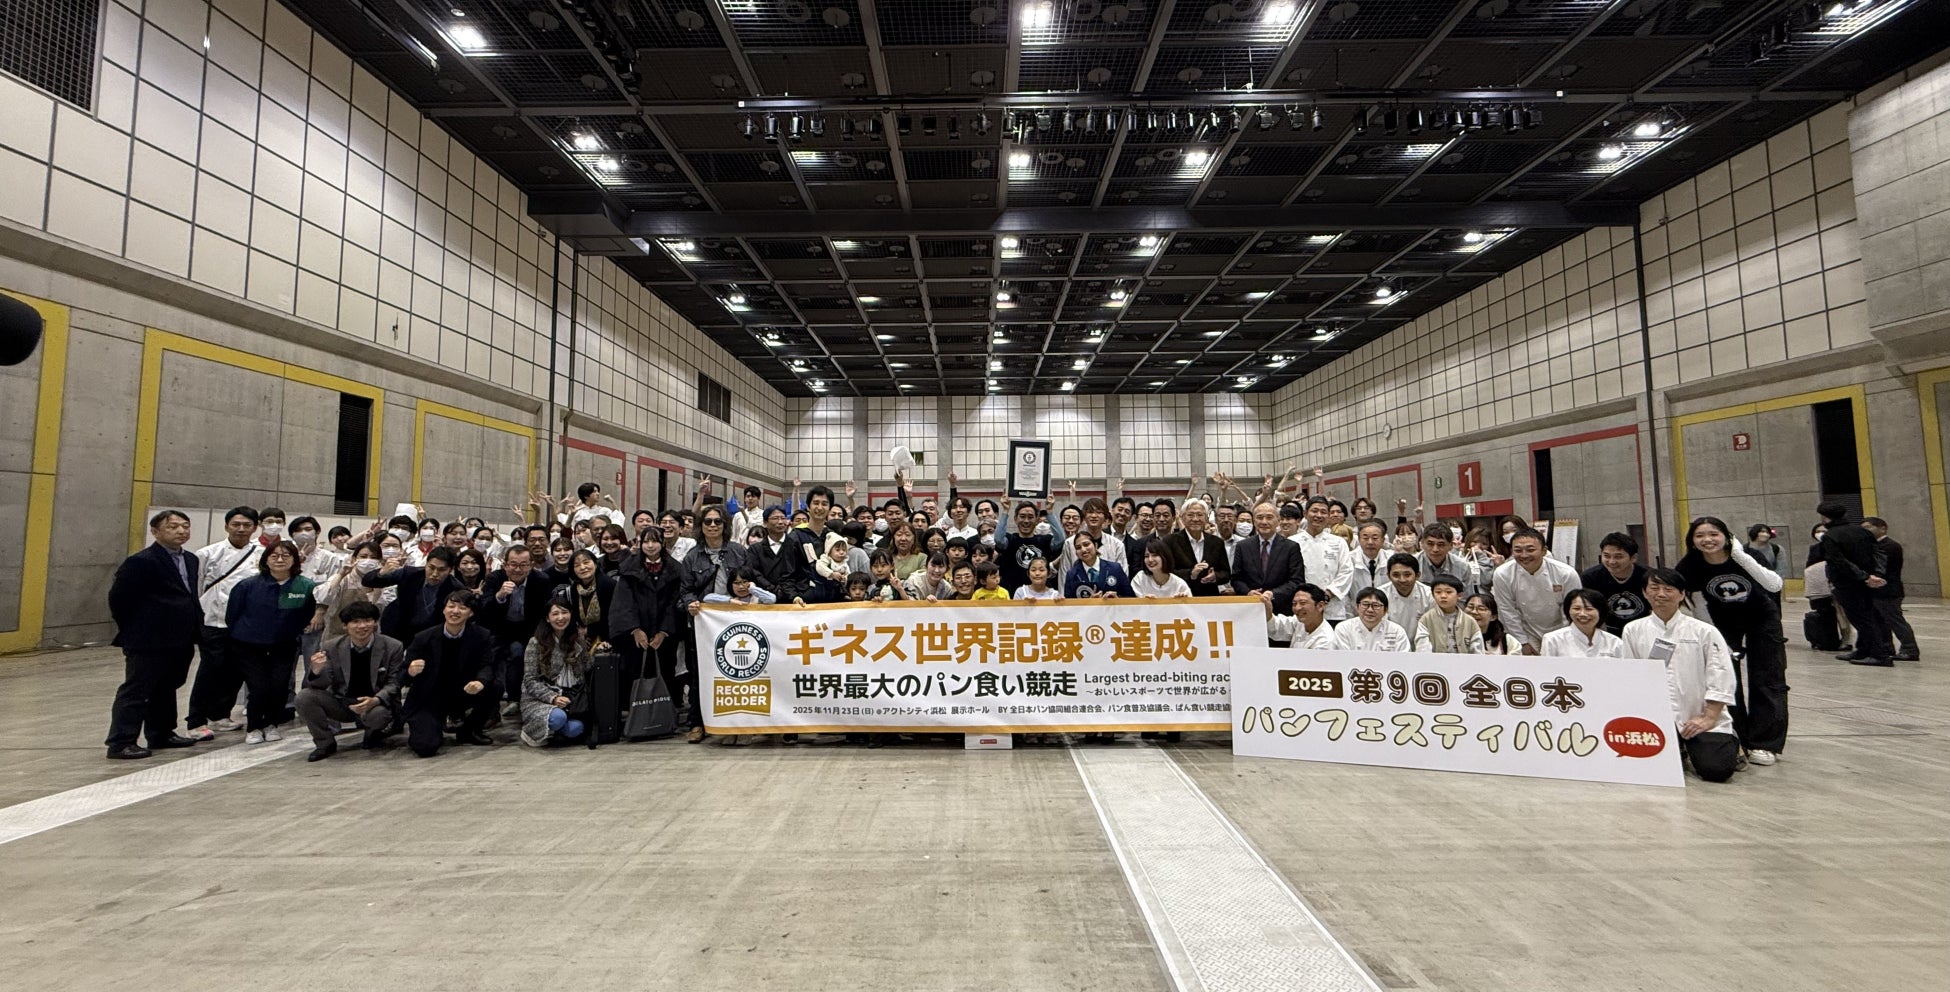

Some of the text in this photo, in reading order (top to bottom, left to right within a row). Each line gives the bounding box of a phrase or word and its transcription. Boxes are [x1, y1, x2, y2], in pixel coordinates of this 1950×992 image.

[1464, 467, 1473, 490] 1
[722, 625, 763, 641] GUINNESS
[717, 647, 768, 678] WORLD RECORDS
[792, 671, 1077, 699] 世界最大のパン食い競走
[1084, 672, 1231, 685] Largest bread-biting rac
[1288, 677, 1333, 692] 2025
[716, 685, 768, 695] RECORD
[1348, 668, 1585, 713] 第9回 全日本
[716, 696, 767, 706] HOLDER
[951, 706, 990, 715] 展示ホール
[998, 706, 1008, 714] BY
[1242, 706, 1599, 757] パンフェスティバル
[1608, 731, 1661, 747] in浜松
